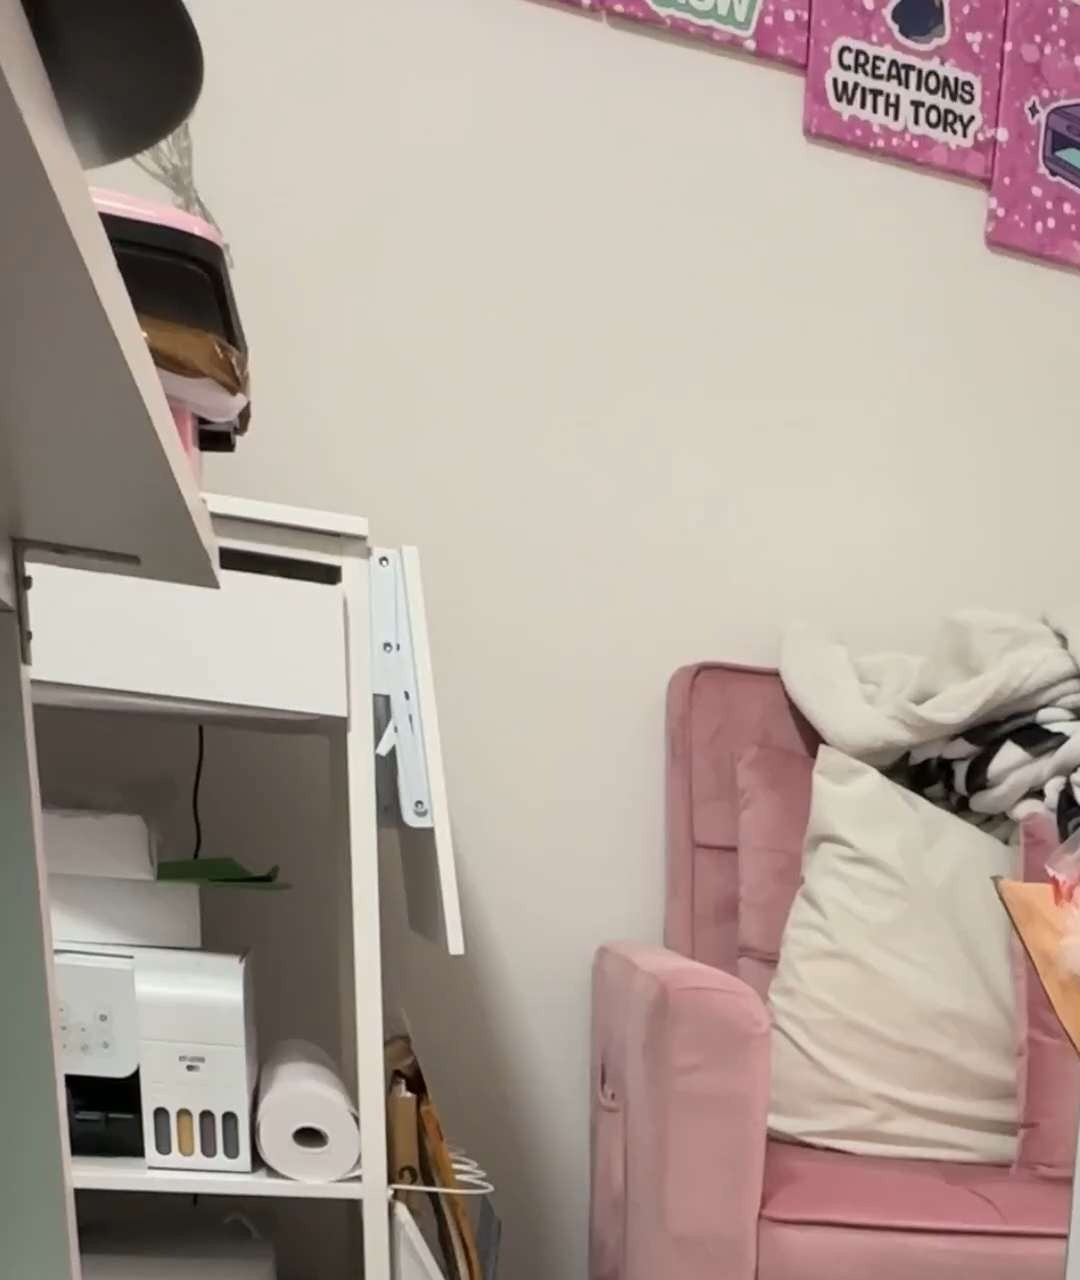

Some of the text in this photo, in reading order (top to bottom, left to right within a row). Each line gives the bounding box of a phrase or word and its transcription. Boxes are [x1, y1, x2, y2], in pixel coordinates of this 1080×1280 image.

[838, 46, 975, 105] CREATIONS
[833, 77, 975, 138] WITH TORY
